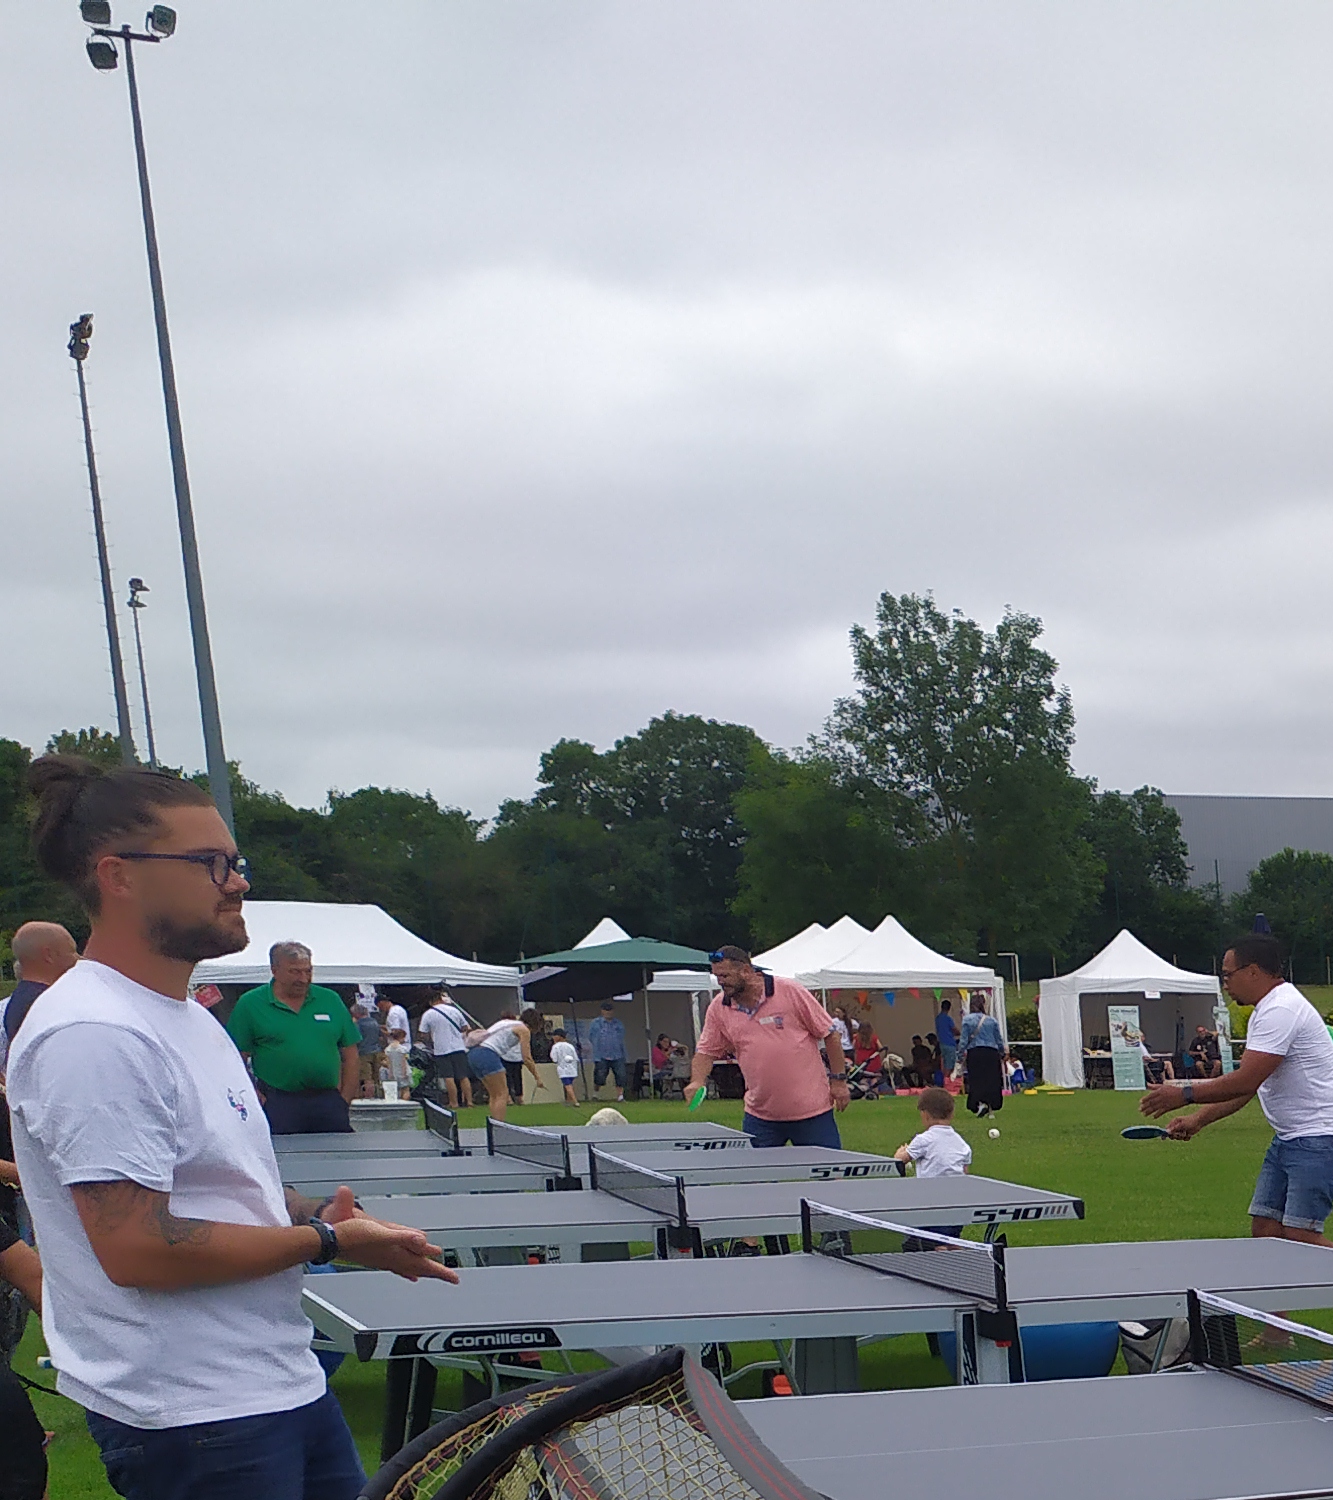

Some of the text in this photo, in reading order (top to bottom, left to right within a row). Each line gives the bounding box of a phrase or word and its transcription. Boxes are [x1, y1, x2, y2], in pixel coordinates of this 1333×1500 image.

[673, 1141, 727, 1151] 540
[809, 1165, 871, 1179] 540
[971, 1207, 1043, 1223] 540
[451, 1332, 546, 1348] cornilleau
